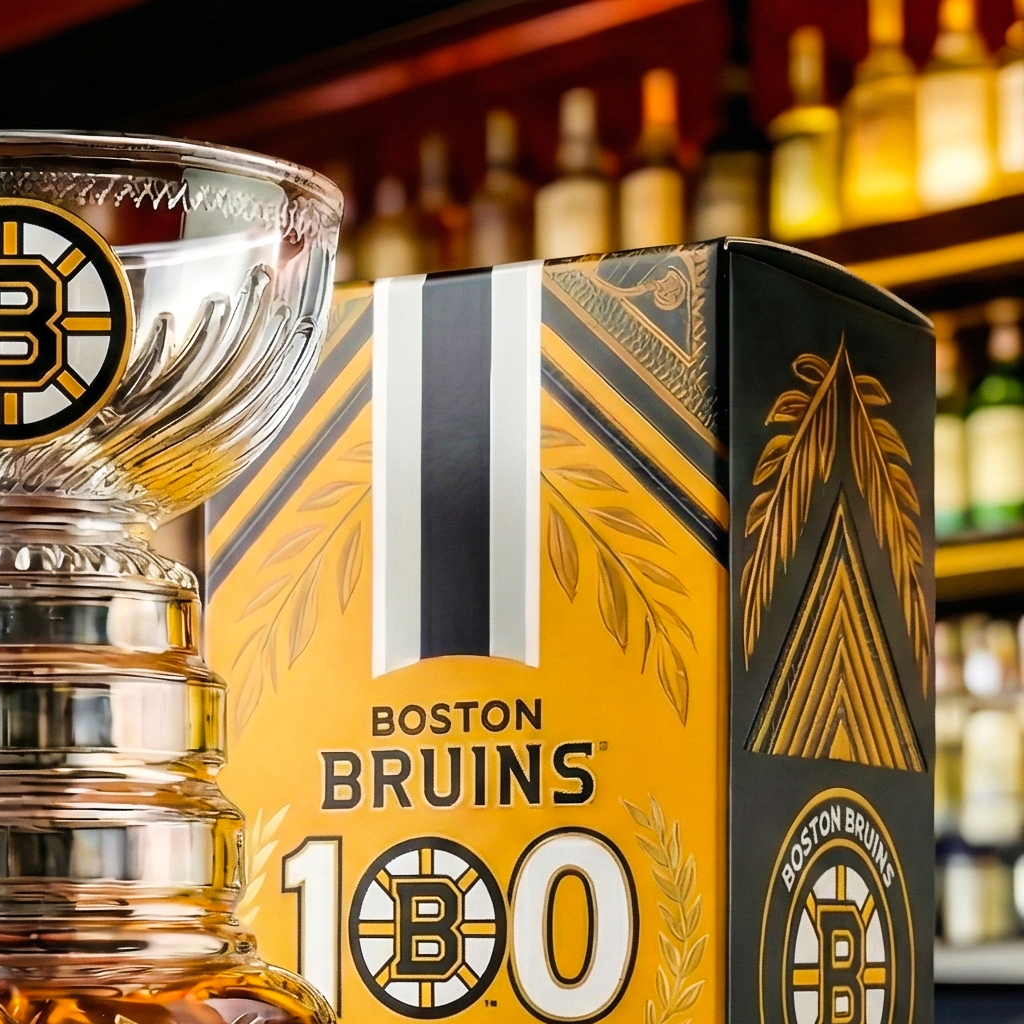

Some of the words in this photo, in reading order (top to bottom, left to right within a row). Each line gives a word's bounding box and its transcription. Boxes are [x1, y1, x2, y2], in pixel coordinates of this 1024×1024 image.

[371, 697, 542, 737] BOSTON
[320, 740, 596, 810] BRUINS
[781, 804, 841, 893] BOSTON
[844, 806, 895, 889] BRUINS
